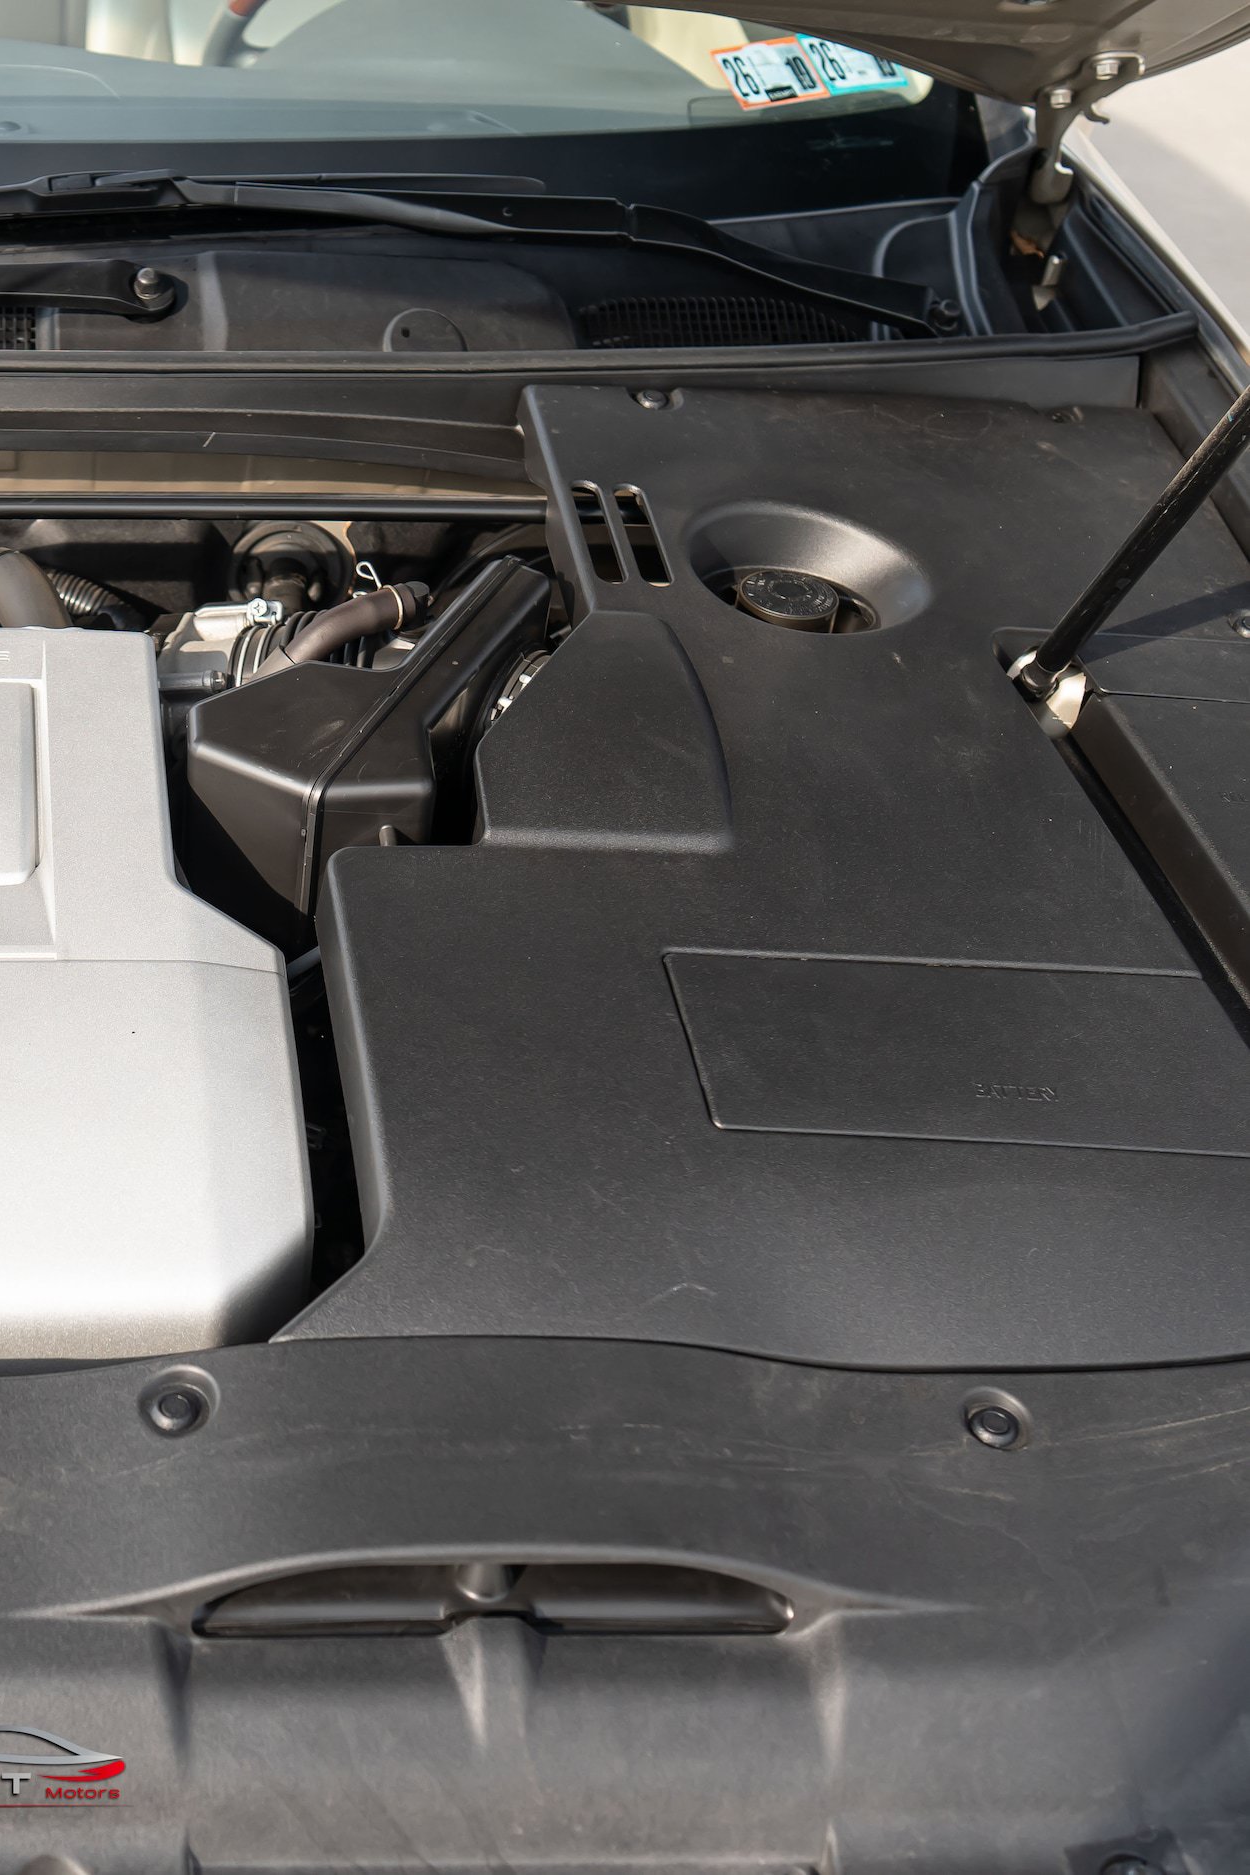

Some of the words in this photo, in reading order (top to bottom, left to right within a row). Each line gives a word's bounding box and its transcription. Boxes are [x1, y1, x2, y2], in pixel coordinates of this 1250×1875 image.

[722, 56, 760, 97] 26
[809, 41, 846, 82] 26
[973, 1082, 1059, 1102] BATTERY
